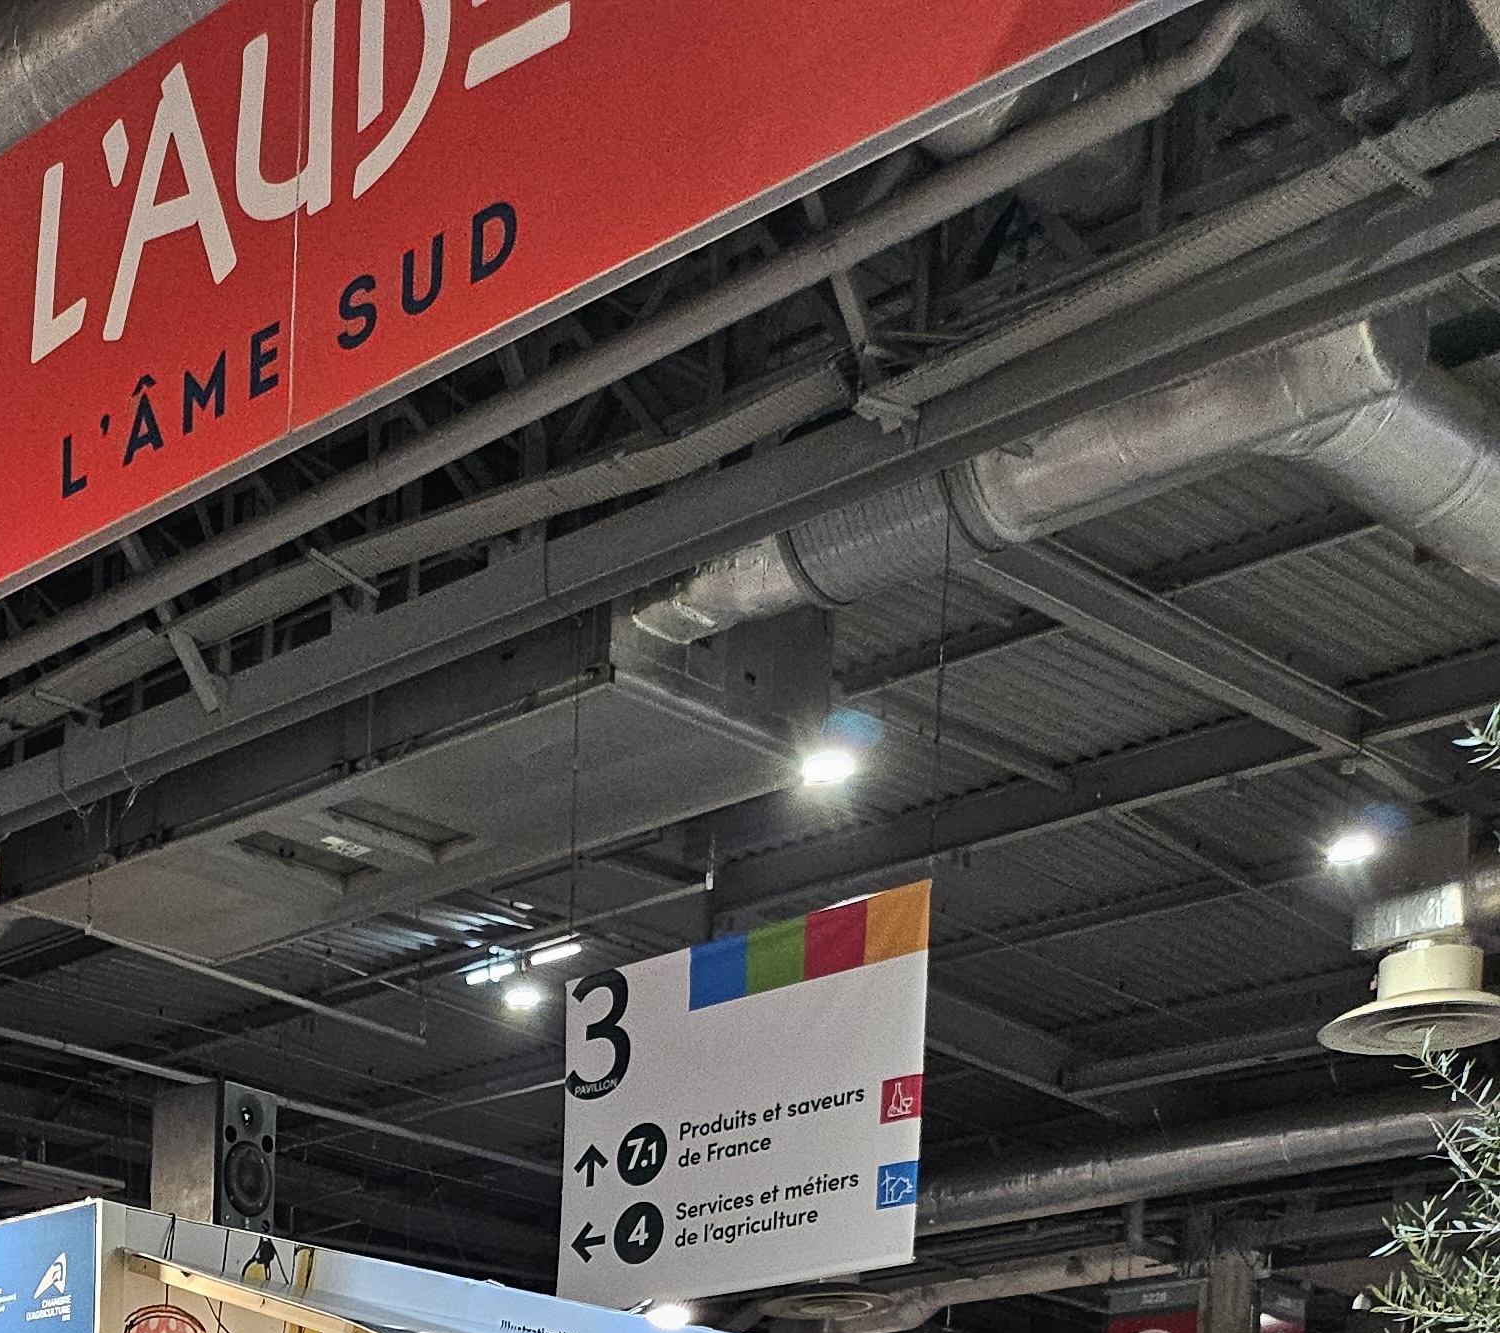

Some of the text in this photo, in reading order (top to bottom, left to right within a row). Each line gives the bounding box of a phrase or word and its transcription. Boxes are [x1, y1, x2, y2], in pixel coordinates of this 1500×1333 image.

[61, 201, 517, 499] L'ÂME SUD
[566, 968, 631, 1100] 3
[574, 1078, 618, 1097] PAVILLON
[627, 1088, 865, 1171] 7.1 Produits et saveurs
[678, 1136, 771, 1168] de France
[627, 1173, 859, 1246] 4 Services et métiers
[674, 1209, 818, 1248] de l'agriculture
